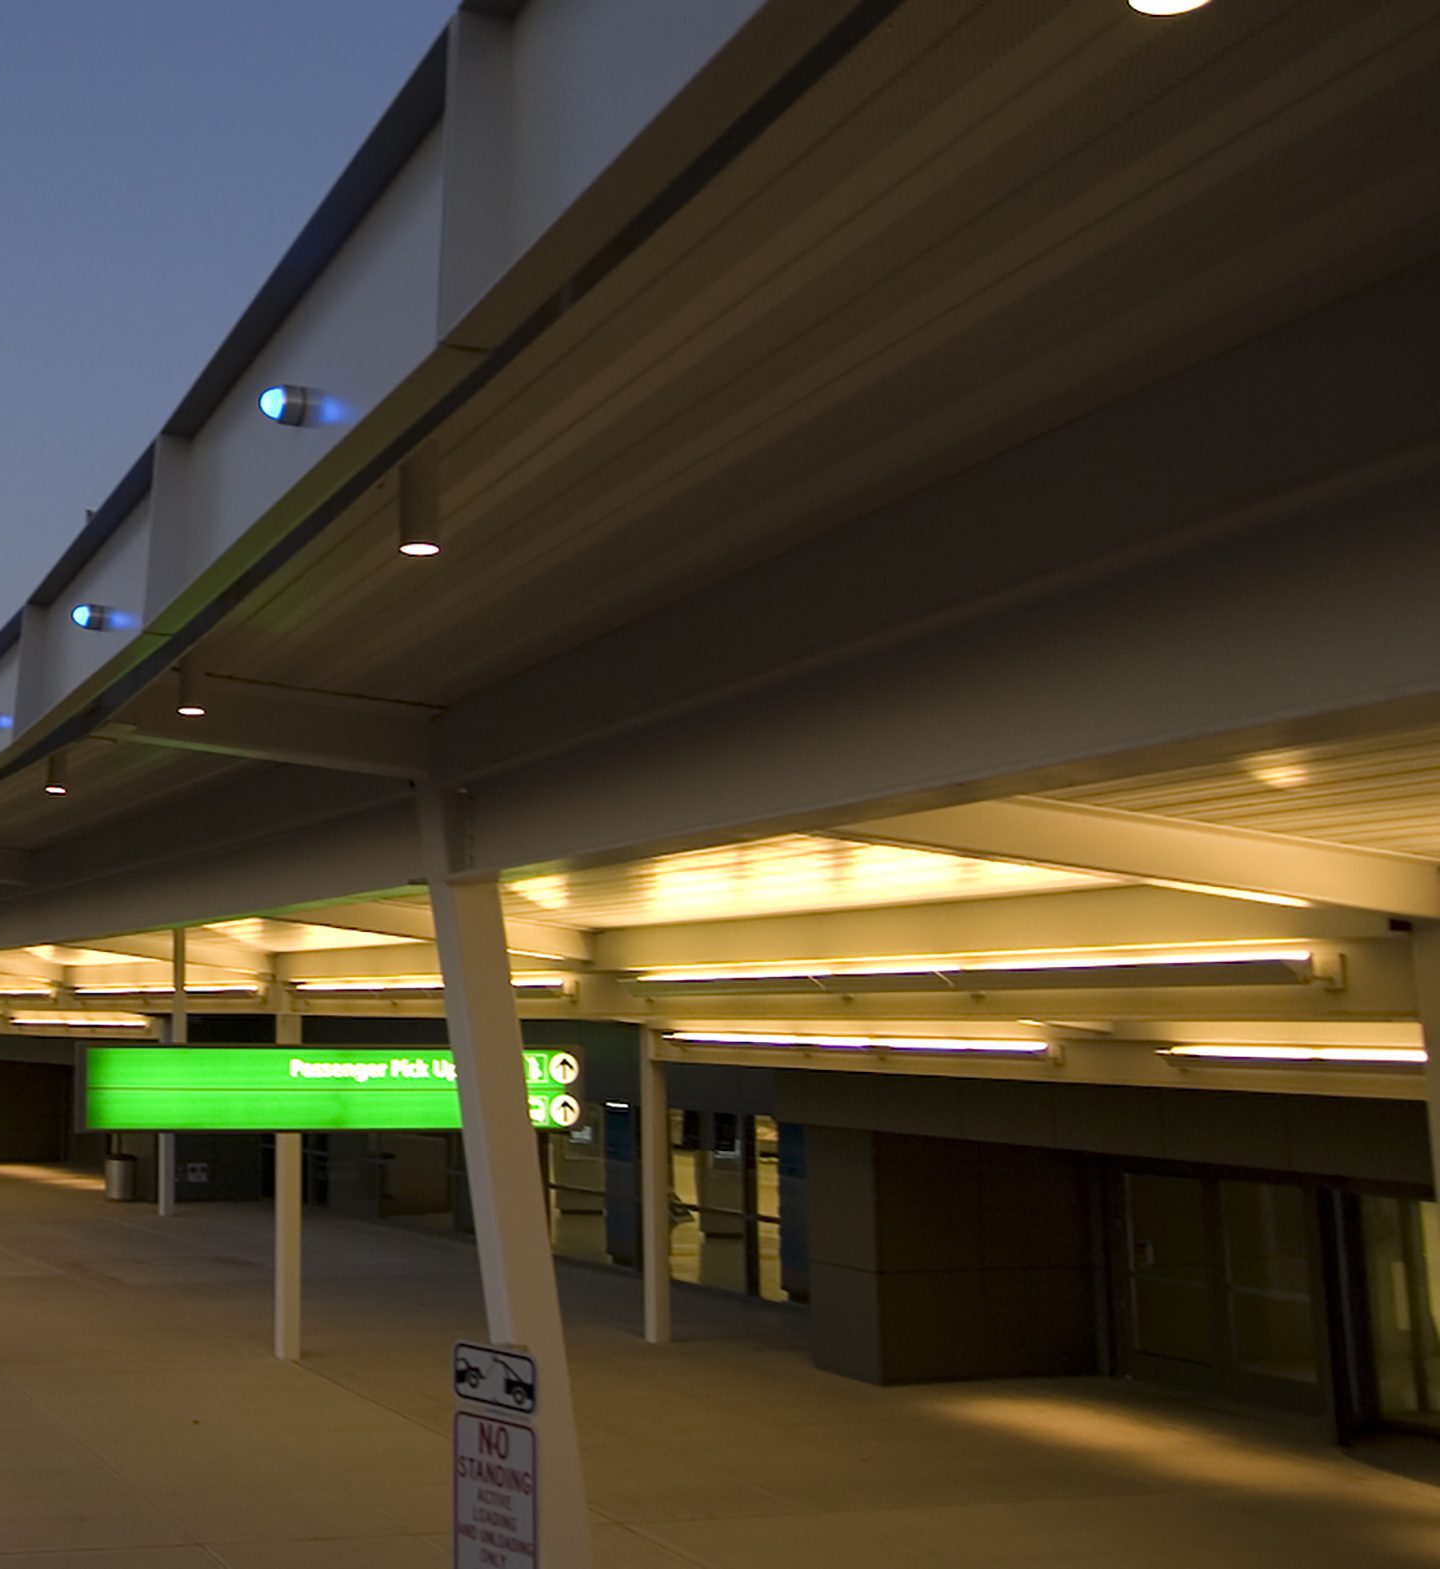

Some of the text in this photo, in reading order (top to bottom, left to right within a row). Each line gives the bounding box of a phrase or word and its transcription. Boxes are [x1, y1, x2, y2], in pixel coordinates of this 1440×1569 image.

[289, 1058, 388, 1083] Passenger
[389, 1058, 430, 1079] Pick
[479, 1422, 509, 1460] NO
[456, 1456, 532, 1495] STANDING
[472, 1504, 517, 1532] LOADING
